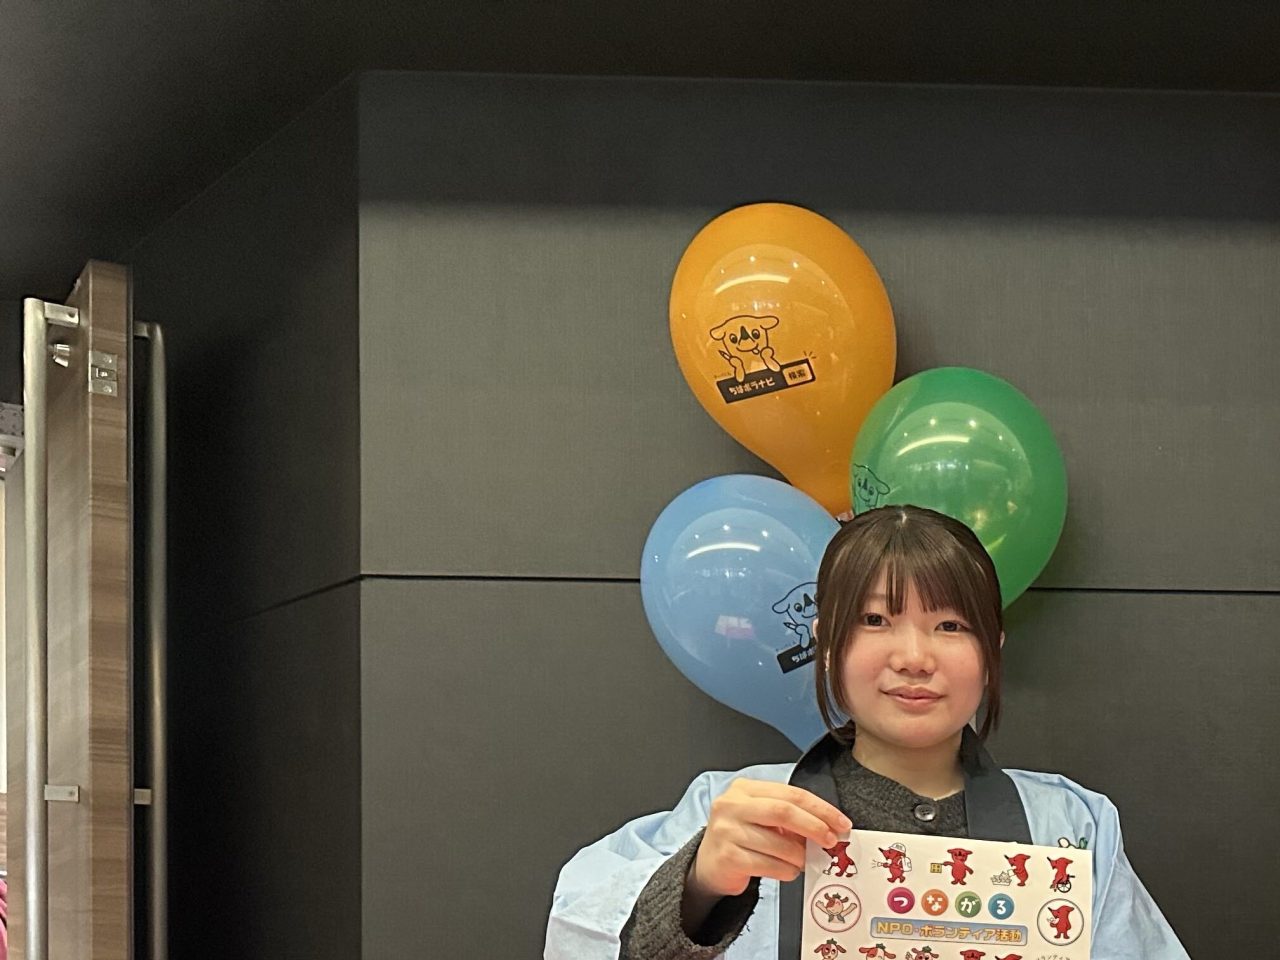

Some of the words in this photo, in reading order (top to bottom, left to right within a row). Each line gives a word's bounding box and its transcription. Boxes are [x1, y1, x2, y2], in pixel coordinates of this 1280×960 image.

[893, 896, 1008, 915] つながる
[876, 921, 1022, 943] NPO・ボランティア活動
